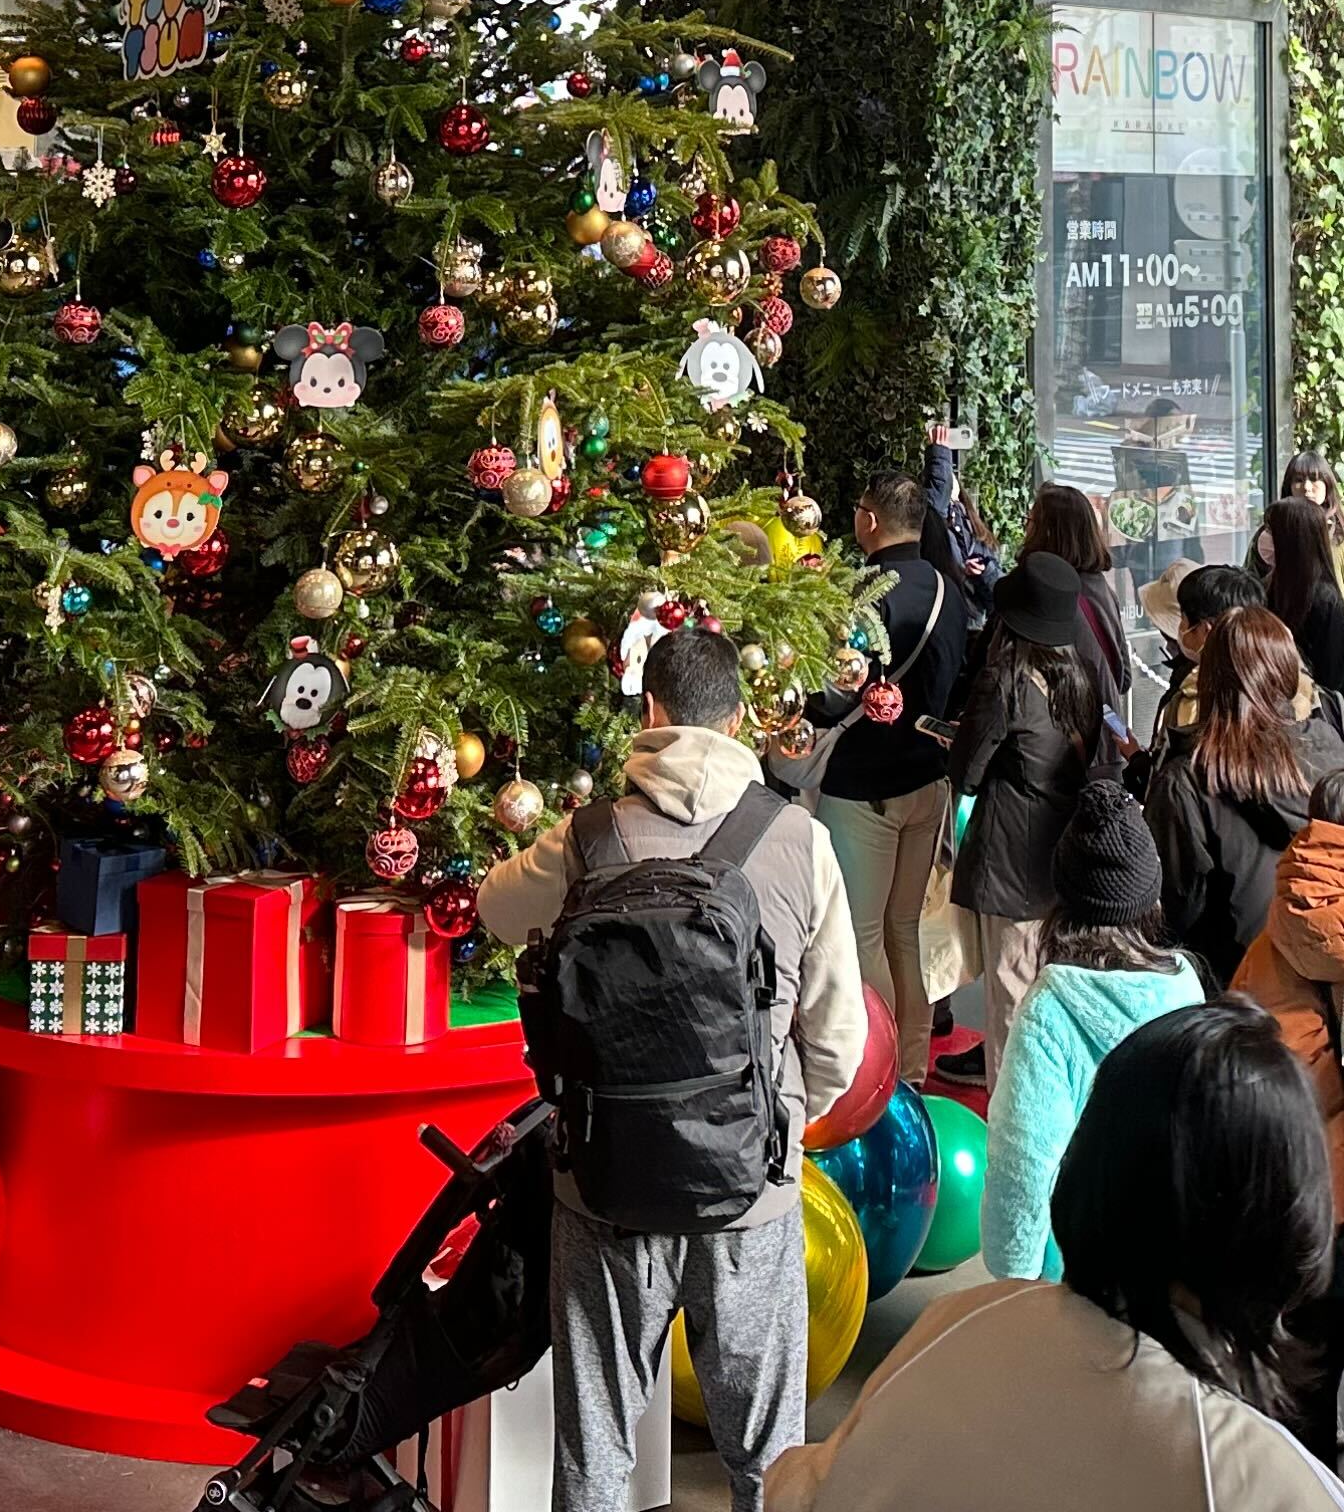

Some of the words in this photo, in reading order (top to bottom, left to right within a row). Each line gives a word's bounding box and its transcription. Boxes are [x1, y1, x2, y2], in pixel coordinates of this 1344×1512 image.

[1052, 42, 1246, 103] RAINBOW
[1066, 220, 1117, 240] 営業時間
[1136, 294, 1243, 330] 翌AM5:00
